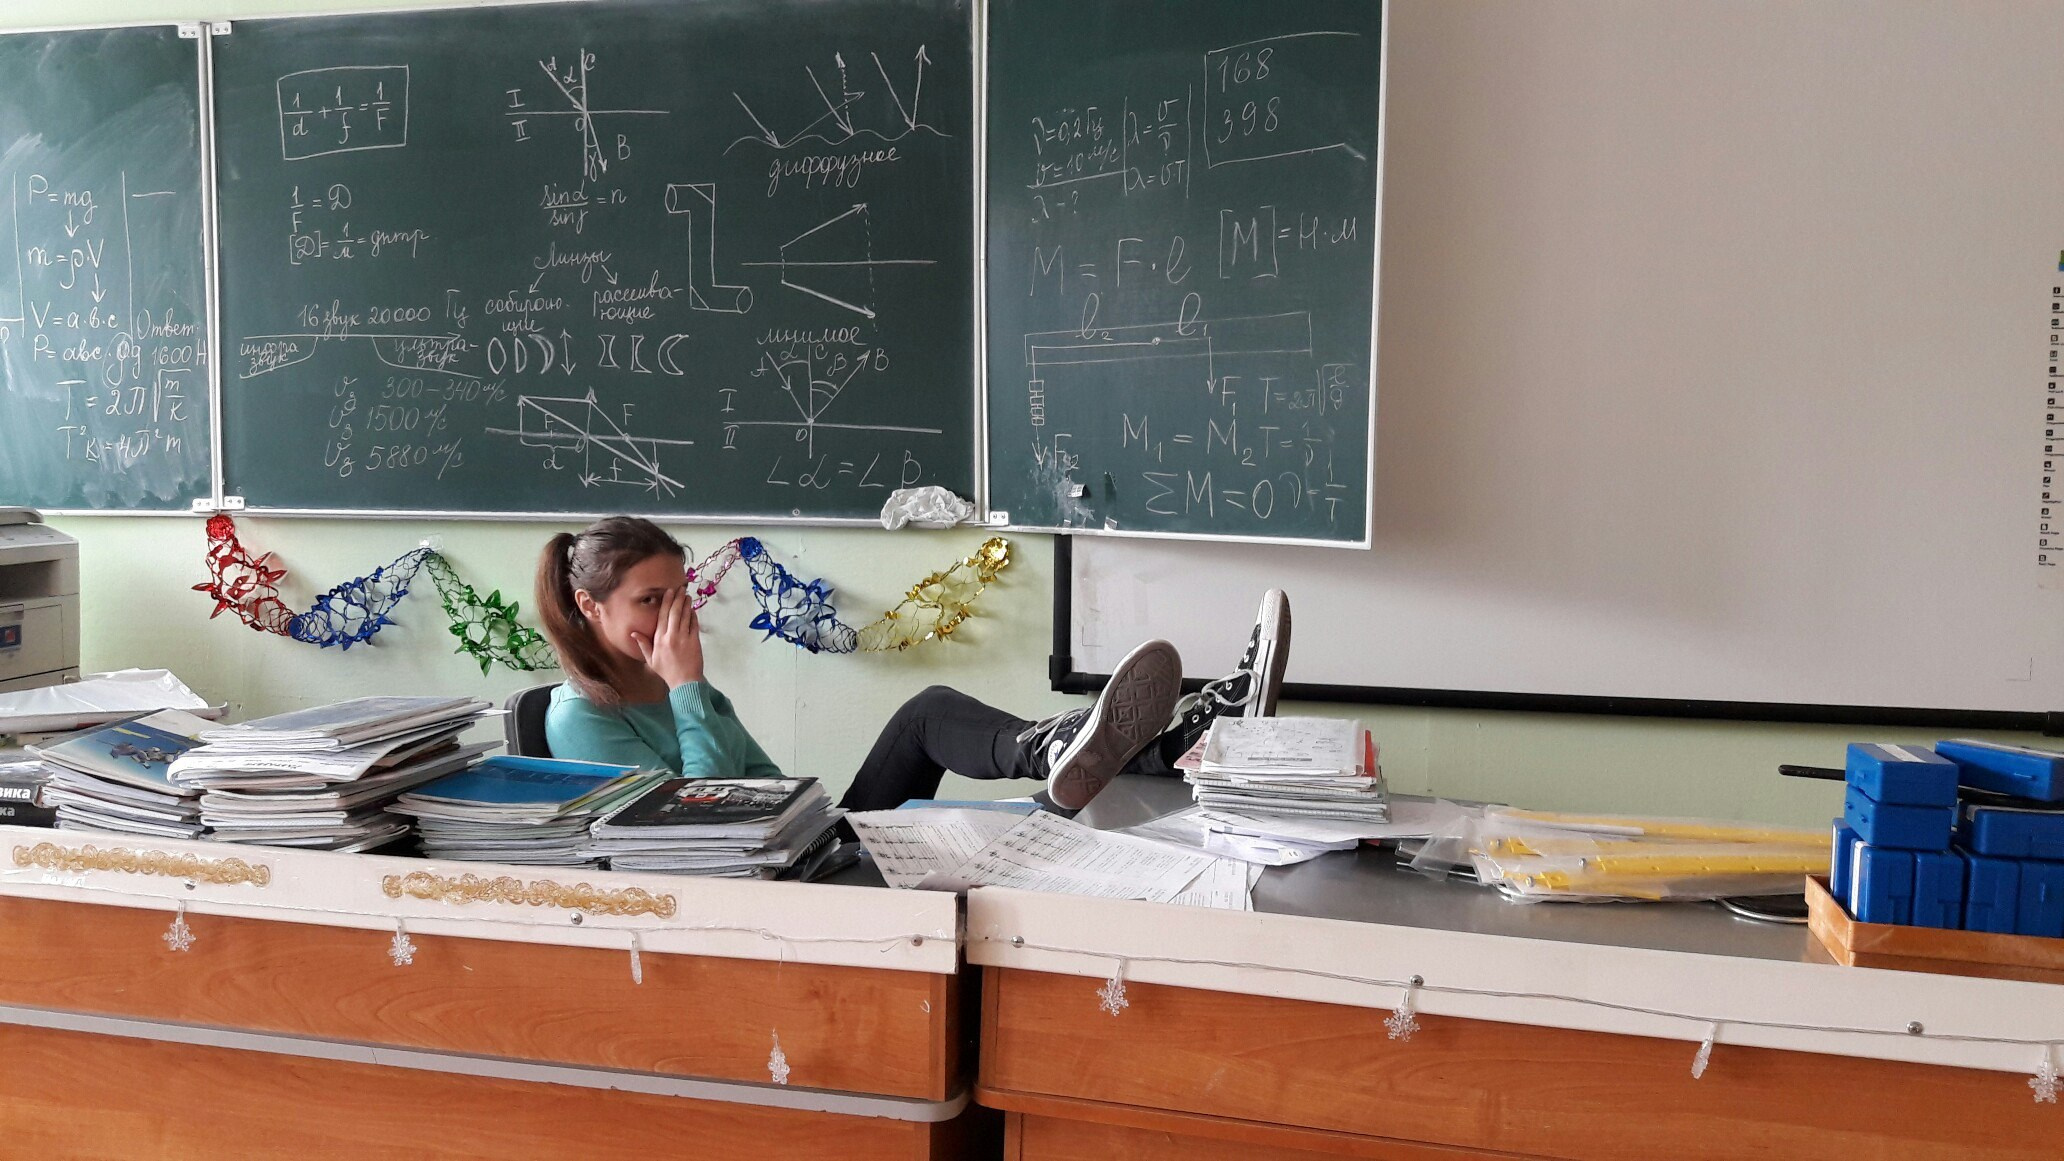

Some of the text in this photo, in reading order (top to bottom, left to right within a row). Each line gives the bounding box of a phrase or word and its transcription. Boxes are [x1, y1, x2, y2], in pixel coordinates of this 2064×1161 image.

[1218, 48, 1274, 93] 168
[1218, 96, 1280, 143] 398
[617, 134, 631, 160] B
[768, 146, 902, 198] диффузное
[533, 241, 612, 283] Линзы
[1031, 245, 1063, 297] M
[298, 304, 319, 328] 16
[322, 299, 361, 341] звук
[368, 306, 431, 325] 20000
[756, 327, 868, 345] мнимое
[151, 345, 192, 365] 1600
[250, 351, 289, 375] звук
[416, 350, 460, 370] звук
[875, 348, 890, 371] B
[366, 405, 420, 431] 1500
[366, 446, 428, 470] 5880
